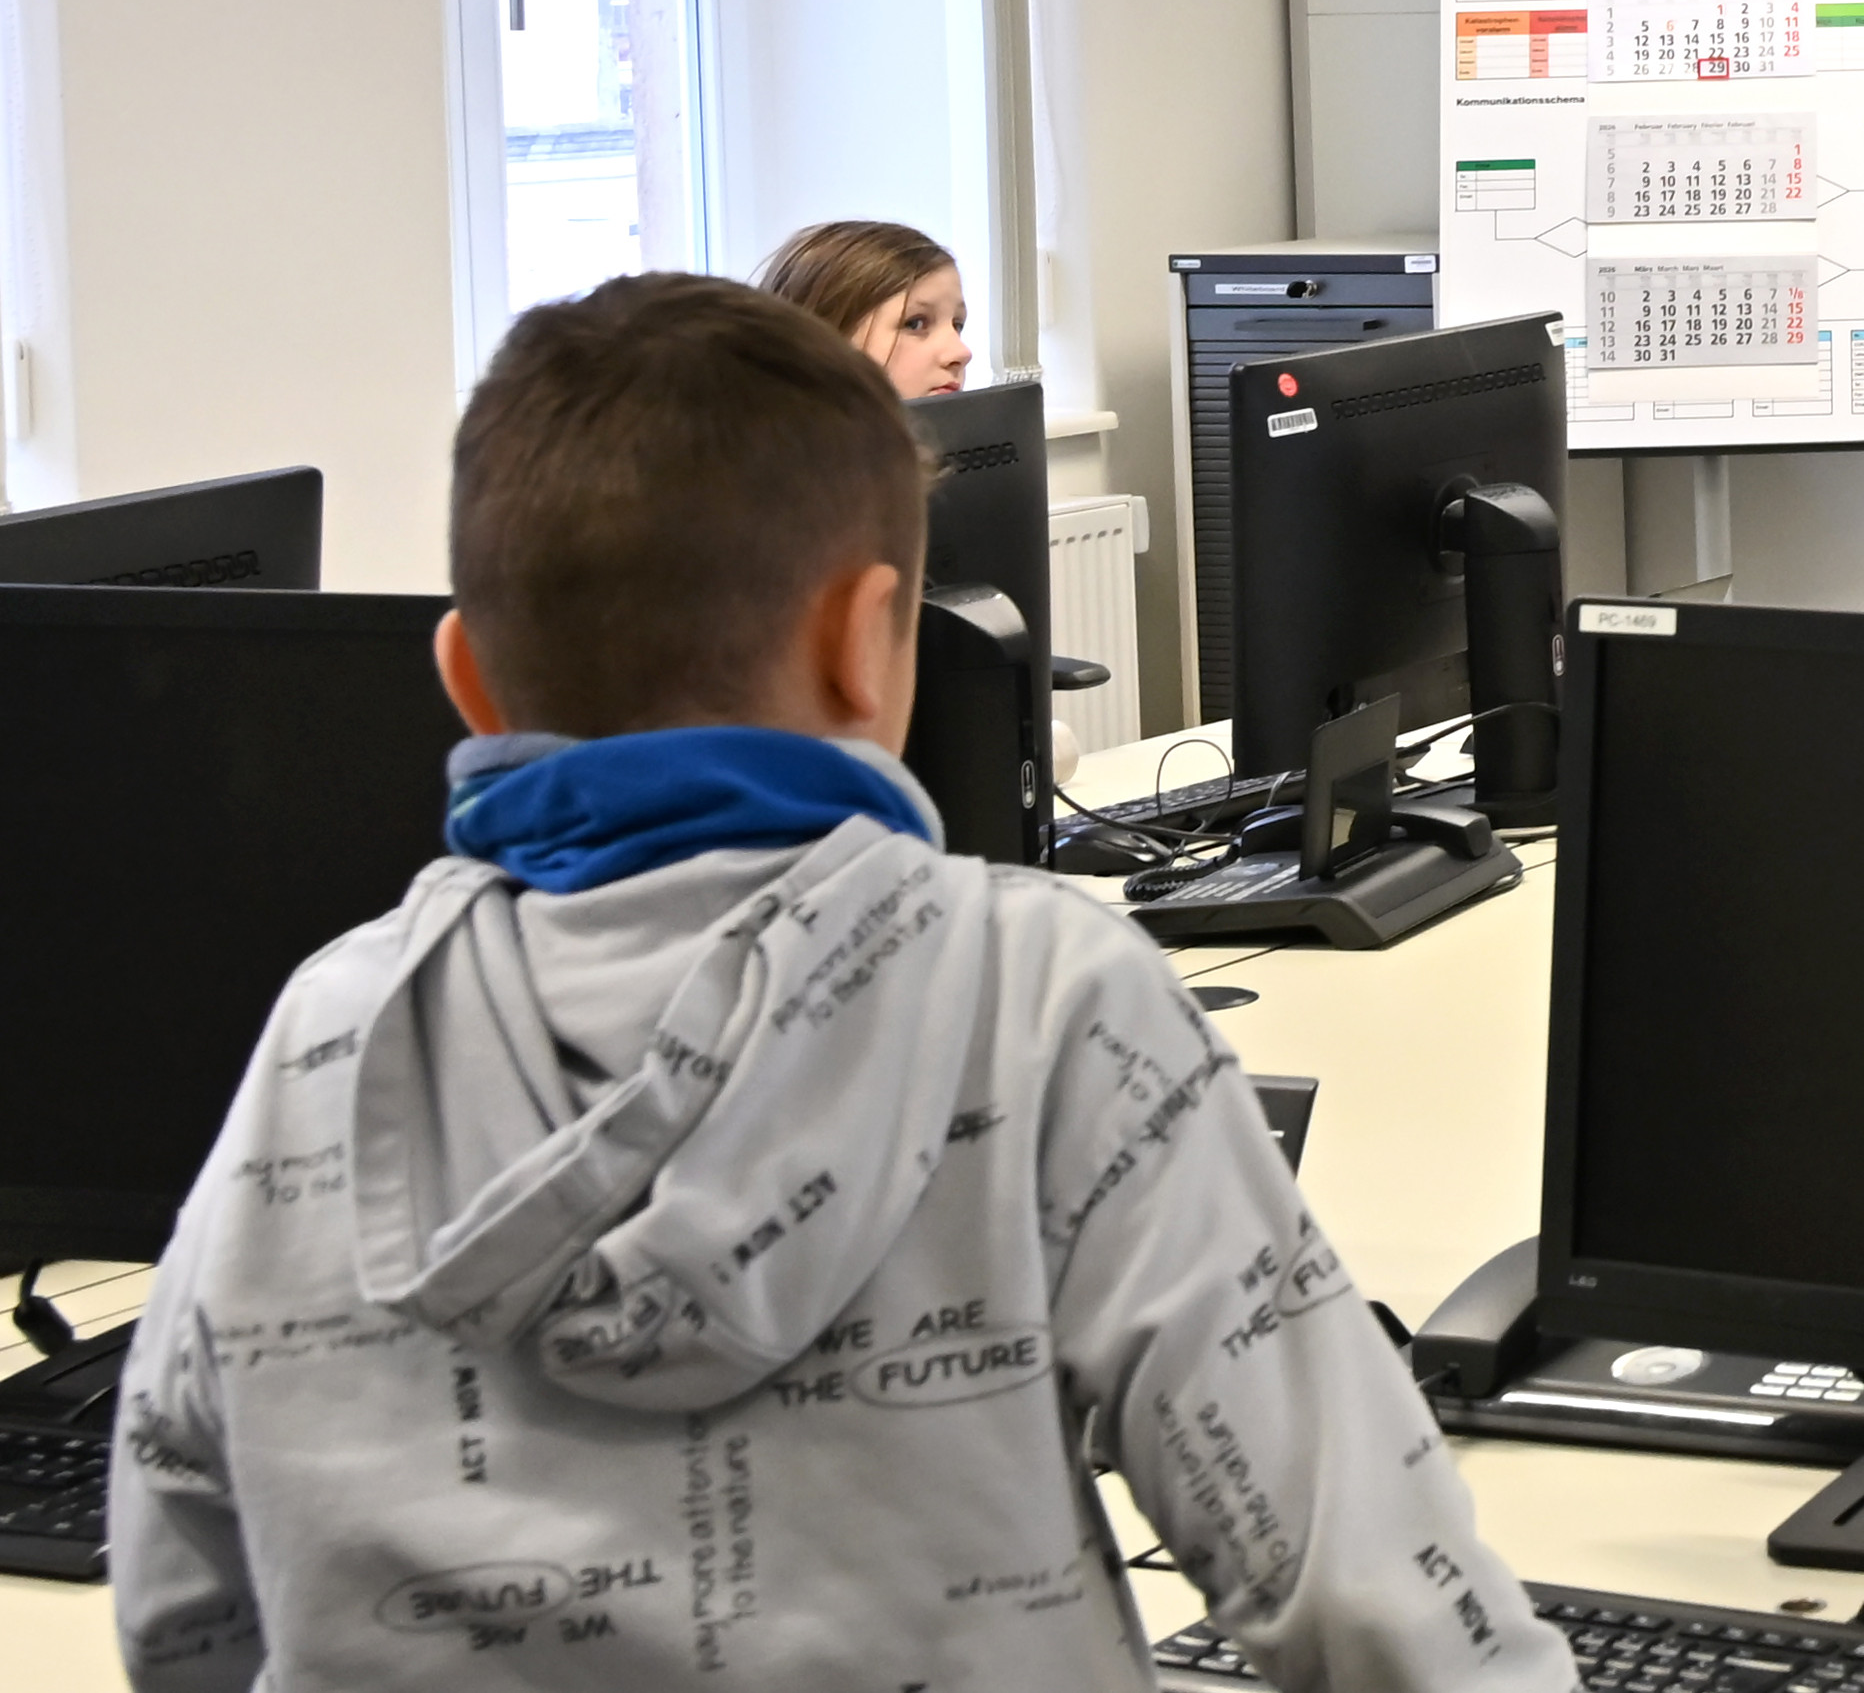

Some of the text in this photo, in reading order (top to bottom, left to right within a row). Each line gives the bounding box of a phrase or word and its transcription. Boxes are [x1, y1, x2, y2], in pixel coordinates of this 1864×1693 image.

[1606, 16, 1799, 34] 2 5 6 7 8 9 10 11
[1456, 96, 1585, 106] Kommunikationsschema
[1607, 172, 1802, 189] 7 9 10 11 12 13 14 15
[1600, 301, 1804, 319] 11 9 10 11 12 13 14 15
[814, 1299, 986, 1355] WE ARE
[878, 1336, 1037, 1391] FUTURE
[451, 1364, 488, 1483] ACT NOW
[719, 1436, 751, 1536] nature
[578, 1559, 661, 1599] THE
[1413, 1542, 1495, 1645] ACT NOW
